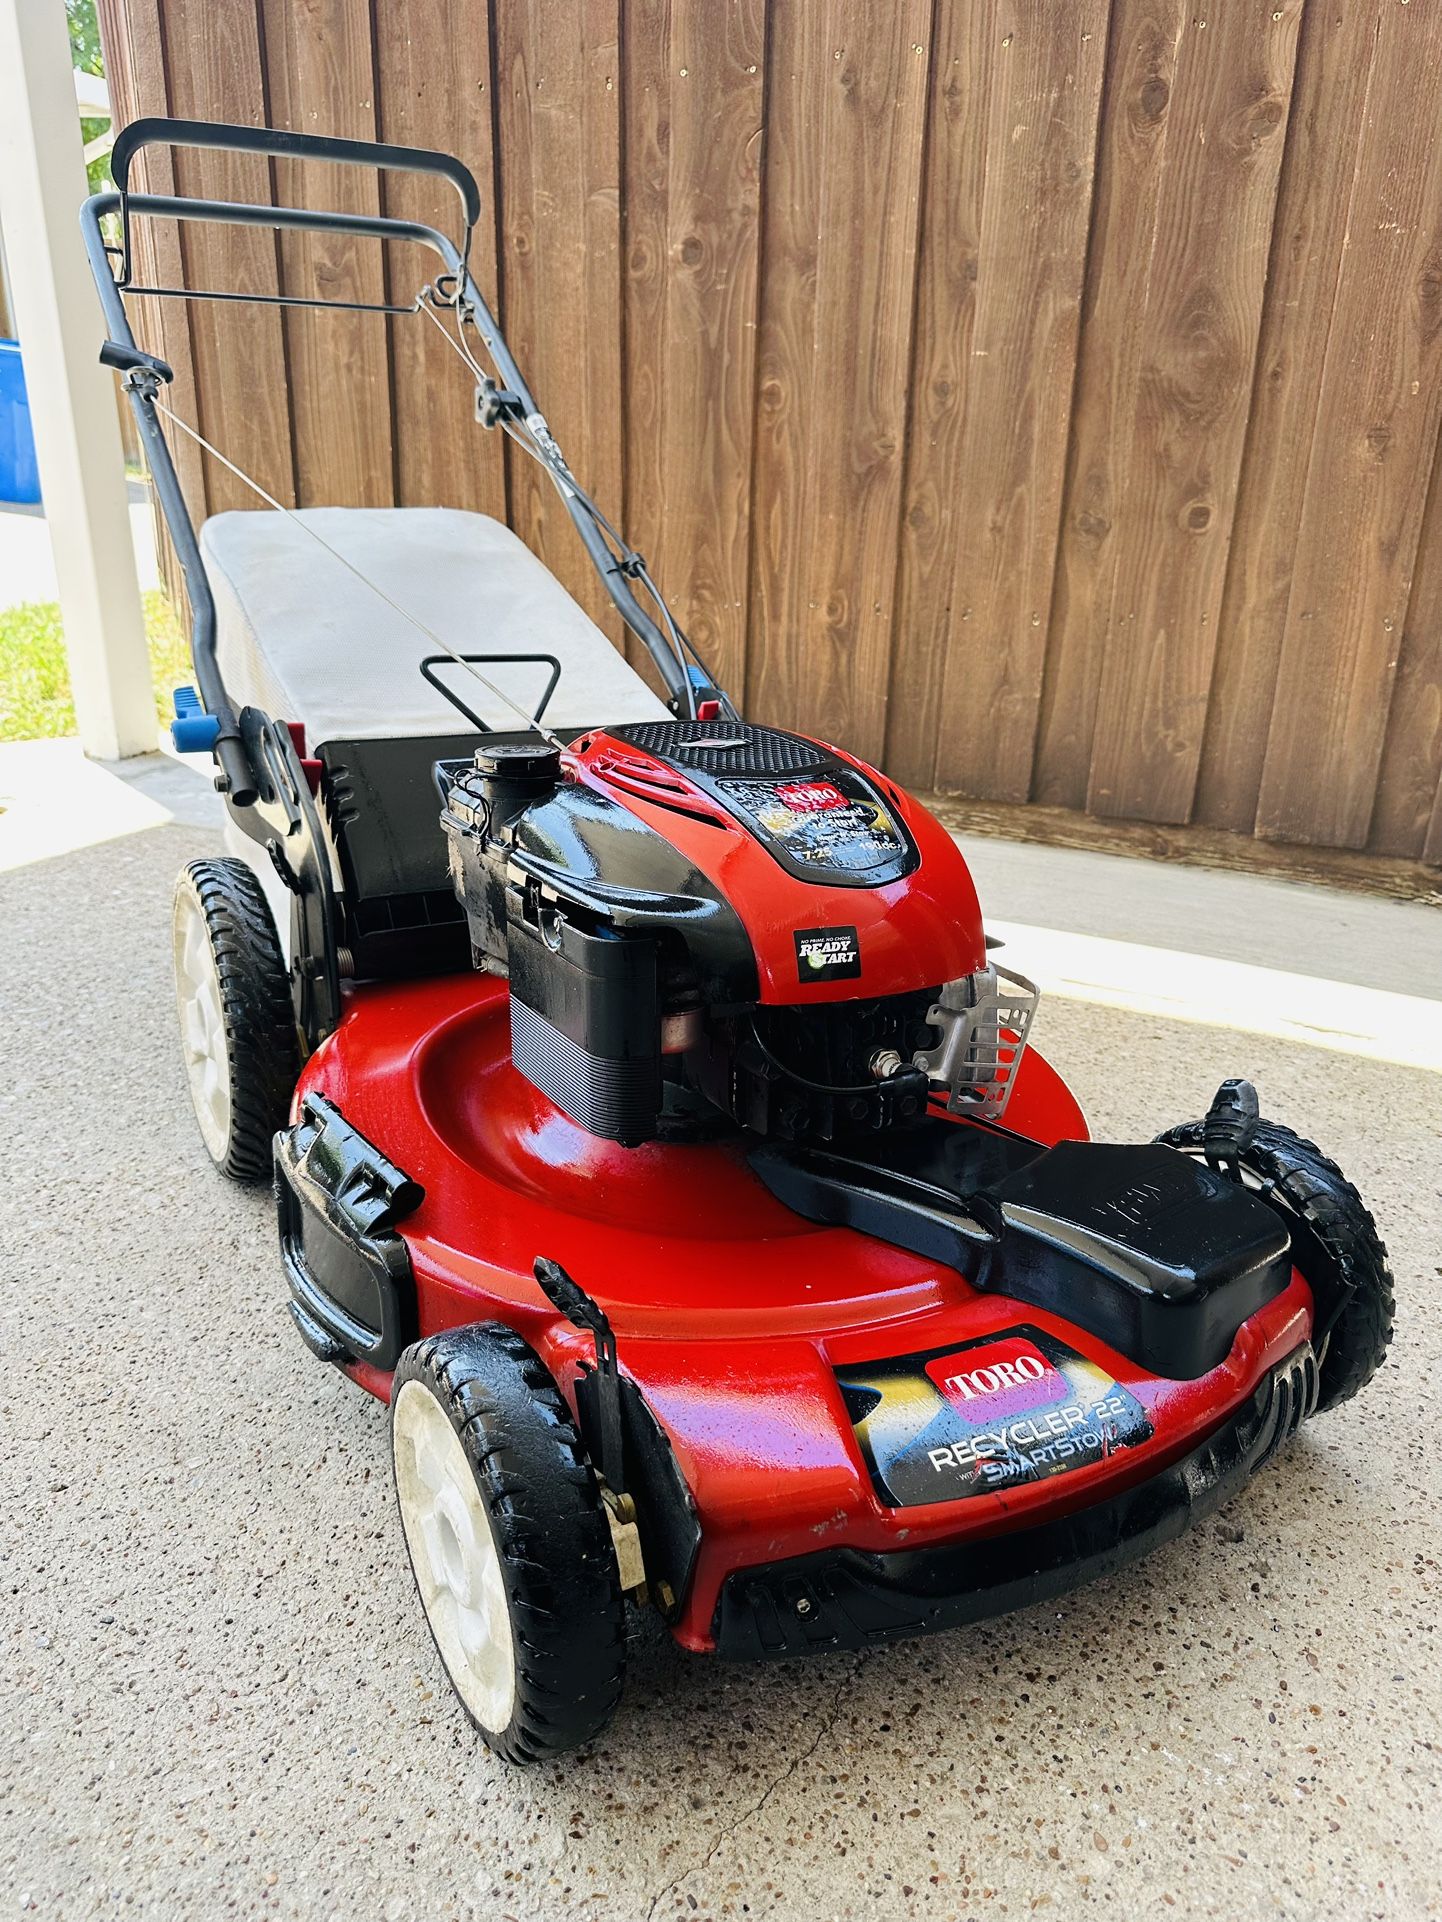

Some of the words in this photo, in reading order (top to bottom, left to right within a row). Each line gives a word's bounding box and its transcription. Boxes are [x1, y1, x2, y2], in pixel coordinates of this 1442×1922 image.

[788, 788, 838, 803] TORO
[799, 941, 851, 957] READY
[812, 951, 857, 965] START
[945, 1355, 1046, 1400] TORO
[927, 1406, 1088, 1472] RECYCLER
